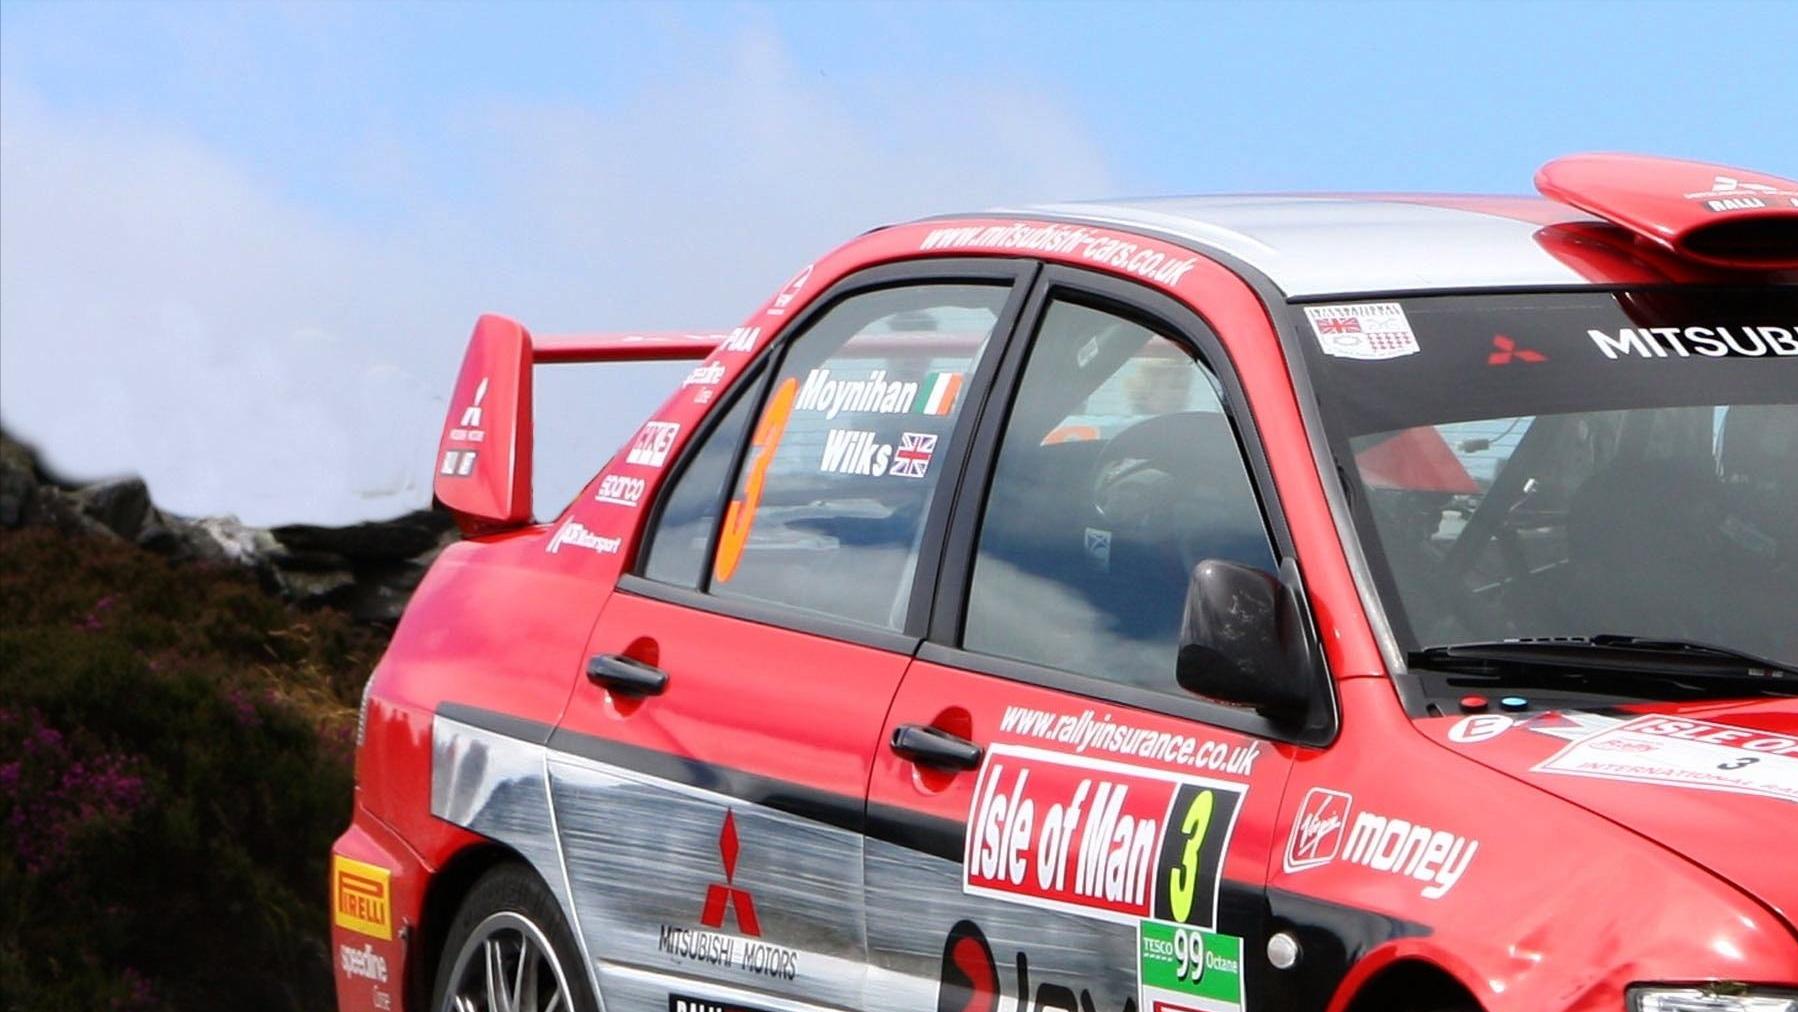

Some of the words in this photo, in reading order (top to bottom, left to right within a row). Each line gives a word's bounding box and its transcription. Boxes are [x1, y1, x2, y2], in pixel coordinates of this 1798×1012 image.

[795, 369, 918, 420] Moynihan
[820, 429, 893, 477] Wilks
[1001, 705, 1260, 776] www.rallyinsurance.co.uk
[1622, 715, 1753, 745] ISLE
[1717, 756, 1760, 770] 3
[970, 764, 1035, 886] Isle
[1037, 778, 1093, 892] of
[1075, 780, 1157, 907] Man
[1169, 789, 1214, 924] 3
[1341, 811, 1479, 900] money
[339, 869, 386, 926] PIRELLI
[658, 924, 735, 968] MITSUBISHI
[740, 942, 798, 981] MOTORS
[1144, 936, 1173, 956] TESCO
[1174, 928, 1204, 981] 99
[1206, 951, 1238, 975] Octane
